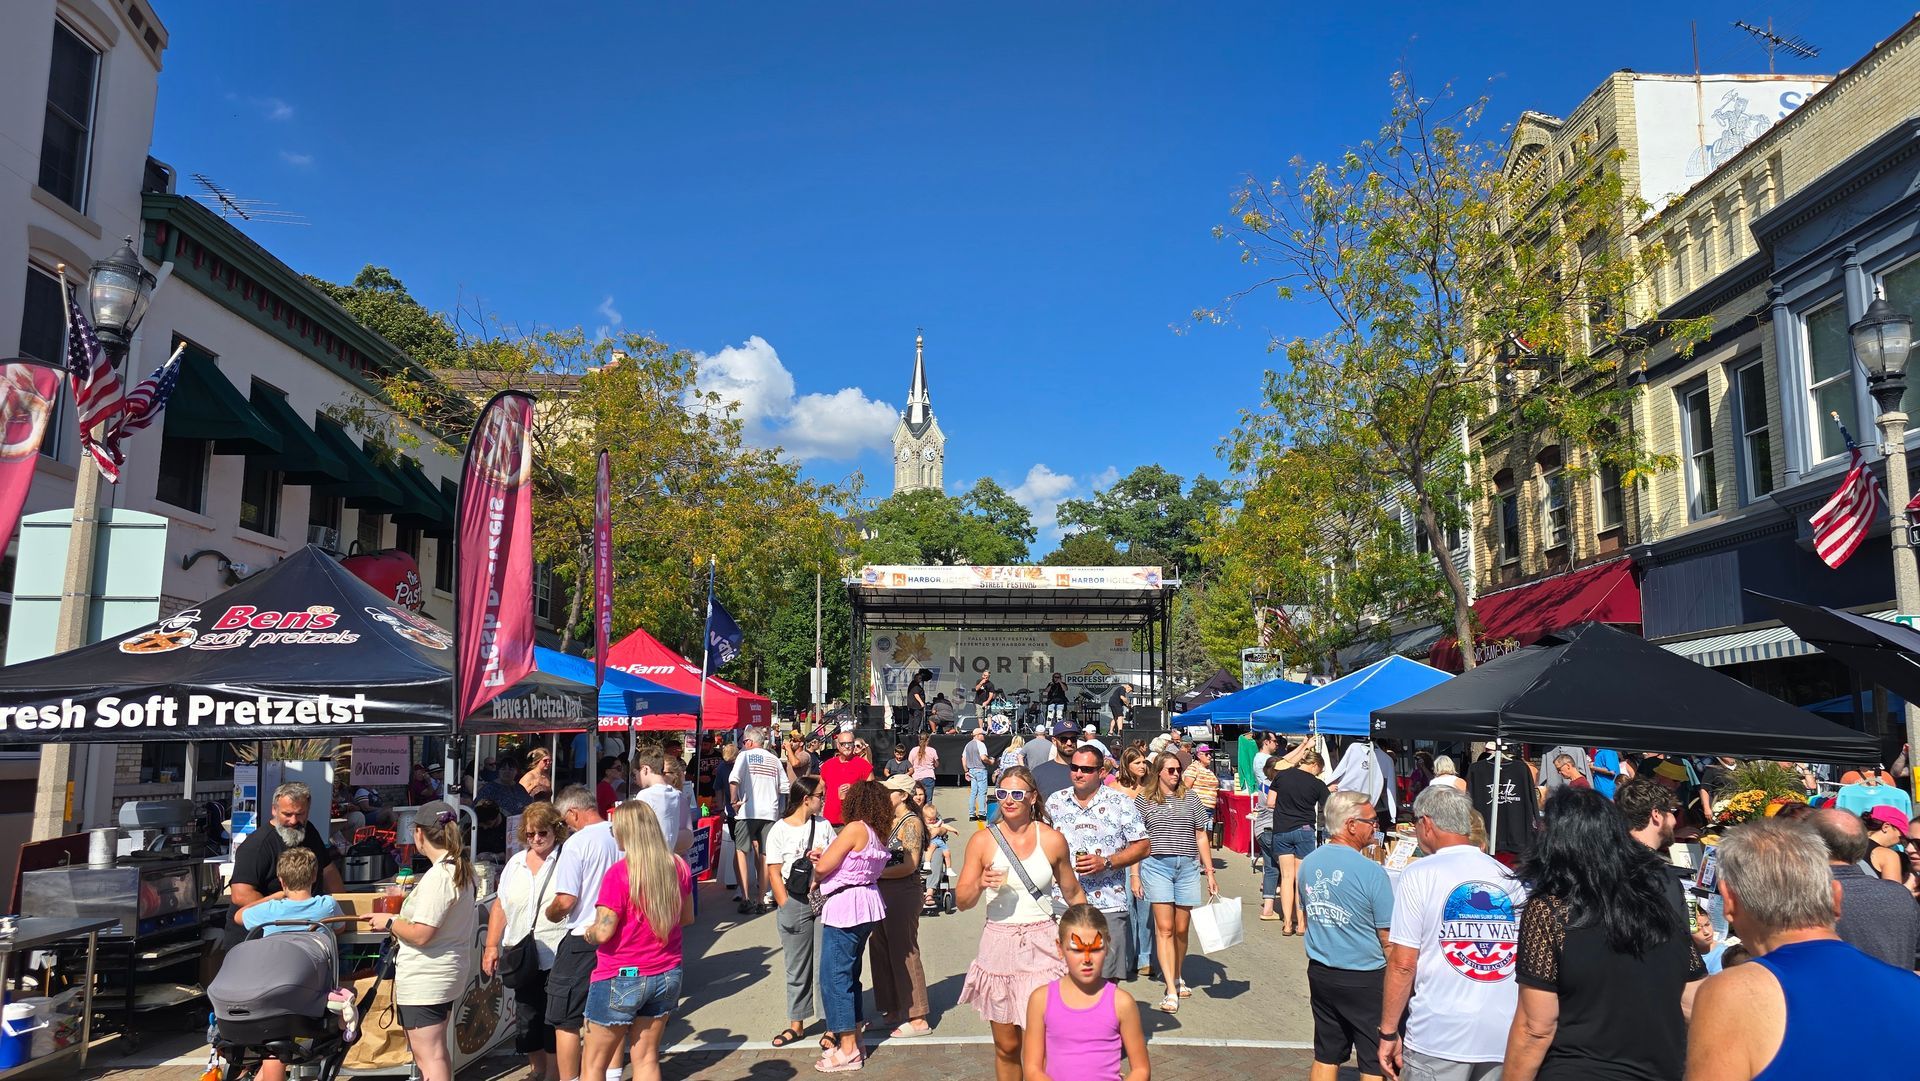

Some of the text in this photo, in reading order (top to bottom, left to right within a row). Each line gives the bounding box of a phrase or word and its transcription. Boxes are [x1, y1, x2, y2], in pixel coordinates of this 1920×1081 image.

[1006, 581, 1037, 589] FESTIVAL
[200, 629, 361, 649] soft pretzels
[949, 655, 1055, 674] NORTH
[0, 693, 366, 729] resh Soft Pretzels!
[492, 693, 584, 723] Have a Pretzel Day!
[362, 761, 401, 775] Kiwanis
[1074, 823, 1098, 831] BREWERS
[1438, 922, 1518, 940] SALTY WAV
